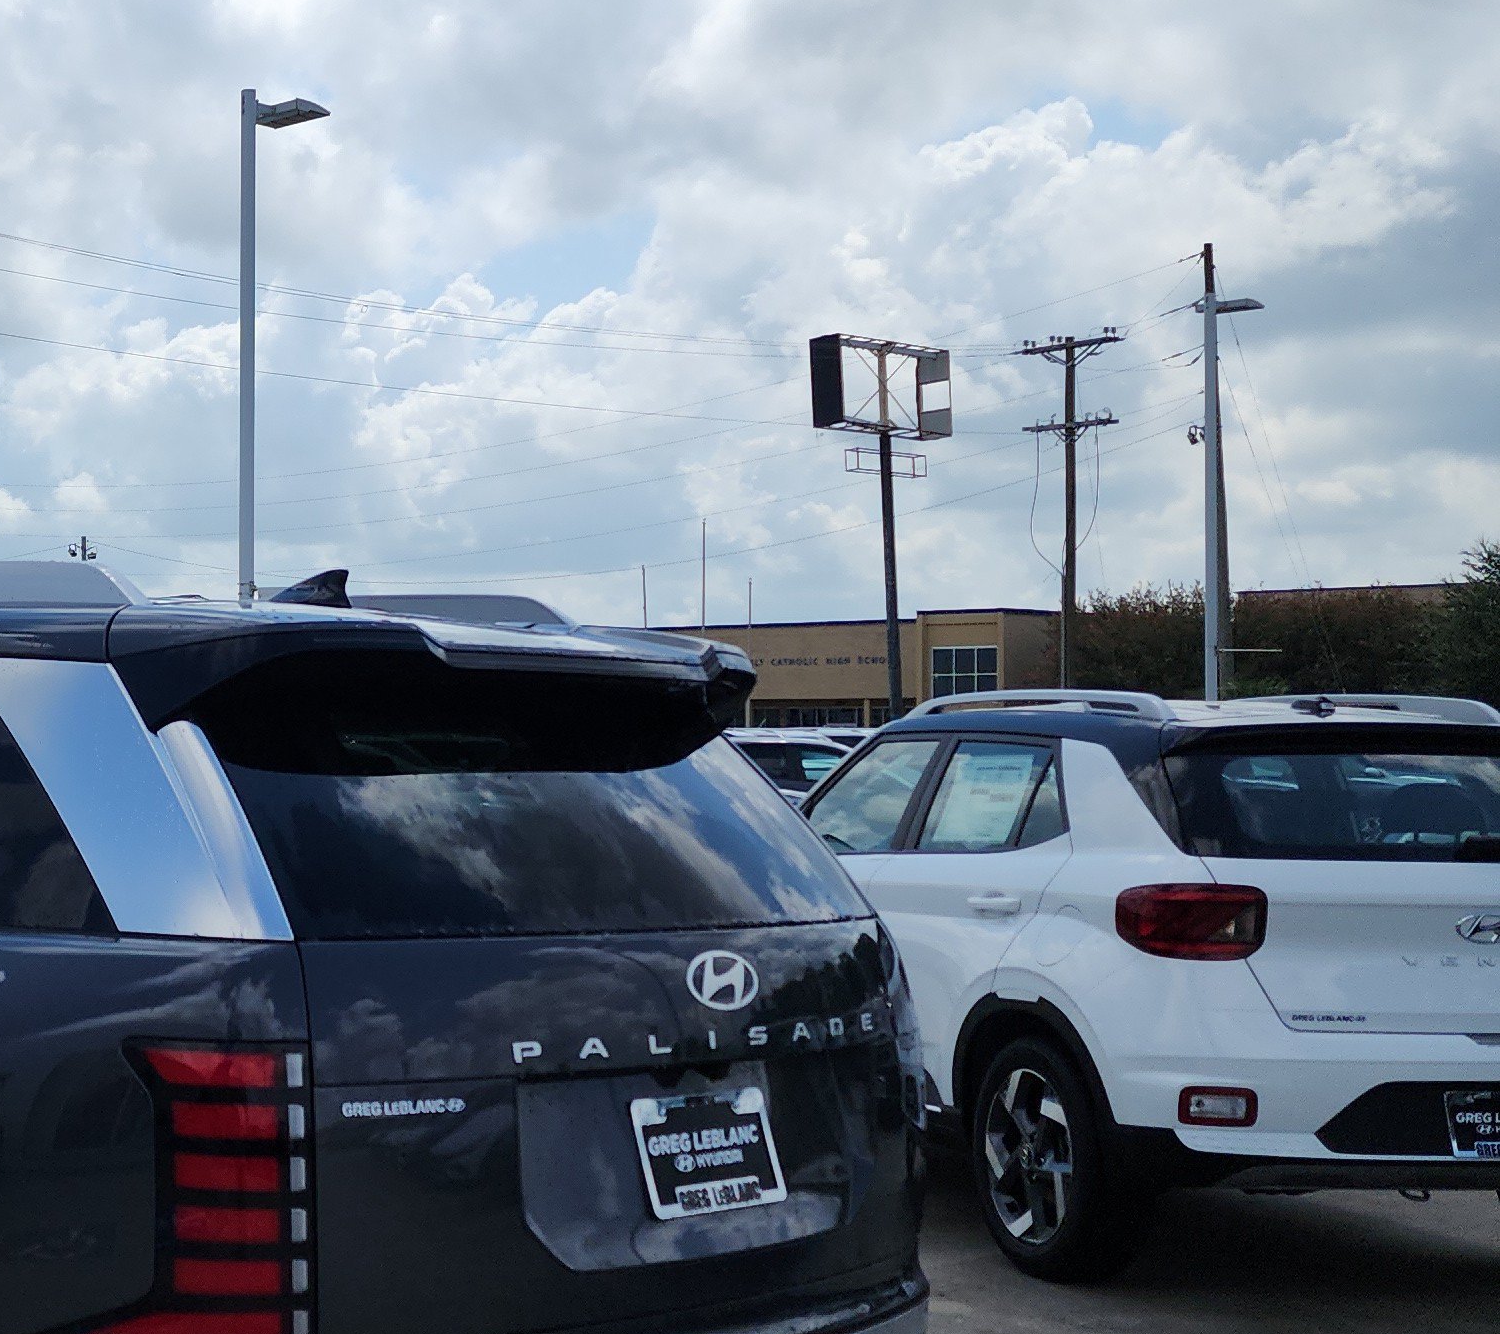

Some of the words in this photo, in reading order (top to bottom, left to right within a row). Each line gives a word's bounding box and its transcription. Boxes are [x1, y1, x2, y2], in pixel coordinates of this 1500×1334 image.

[770, 657, 818, 666] CATHOLIC
[858, 656, 886, 665] SCHO
[511, 1012, 874, 1064] PALISADE
[342, 1101, 382, 1117] GREG
[384, 1098, 445, 1115] LEBLANC
[1456, 1112, 1492, 1123] GREG
[648, 1132, 692, 1156] GREG
[692, 1123, 759, 1151] LEBLANC
[1477, 1143, 1500, 1158] GRE
